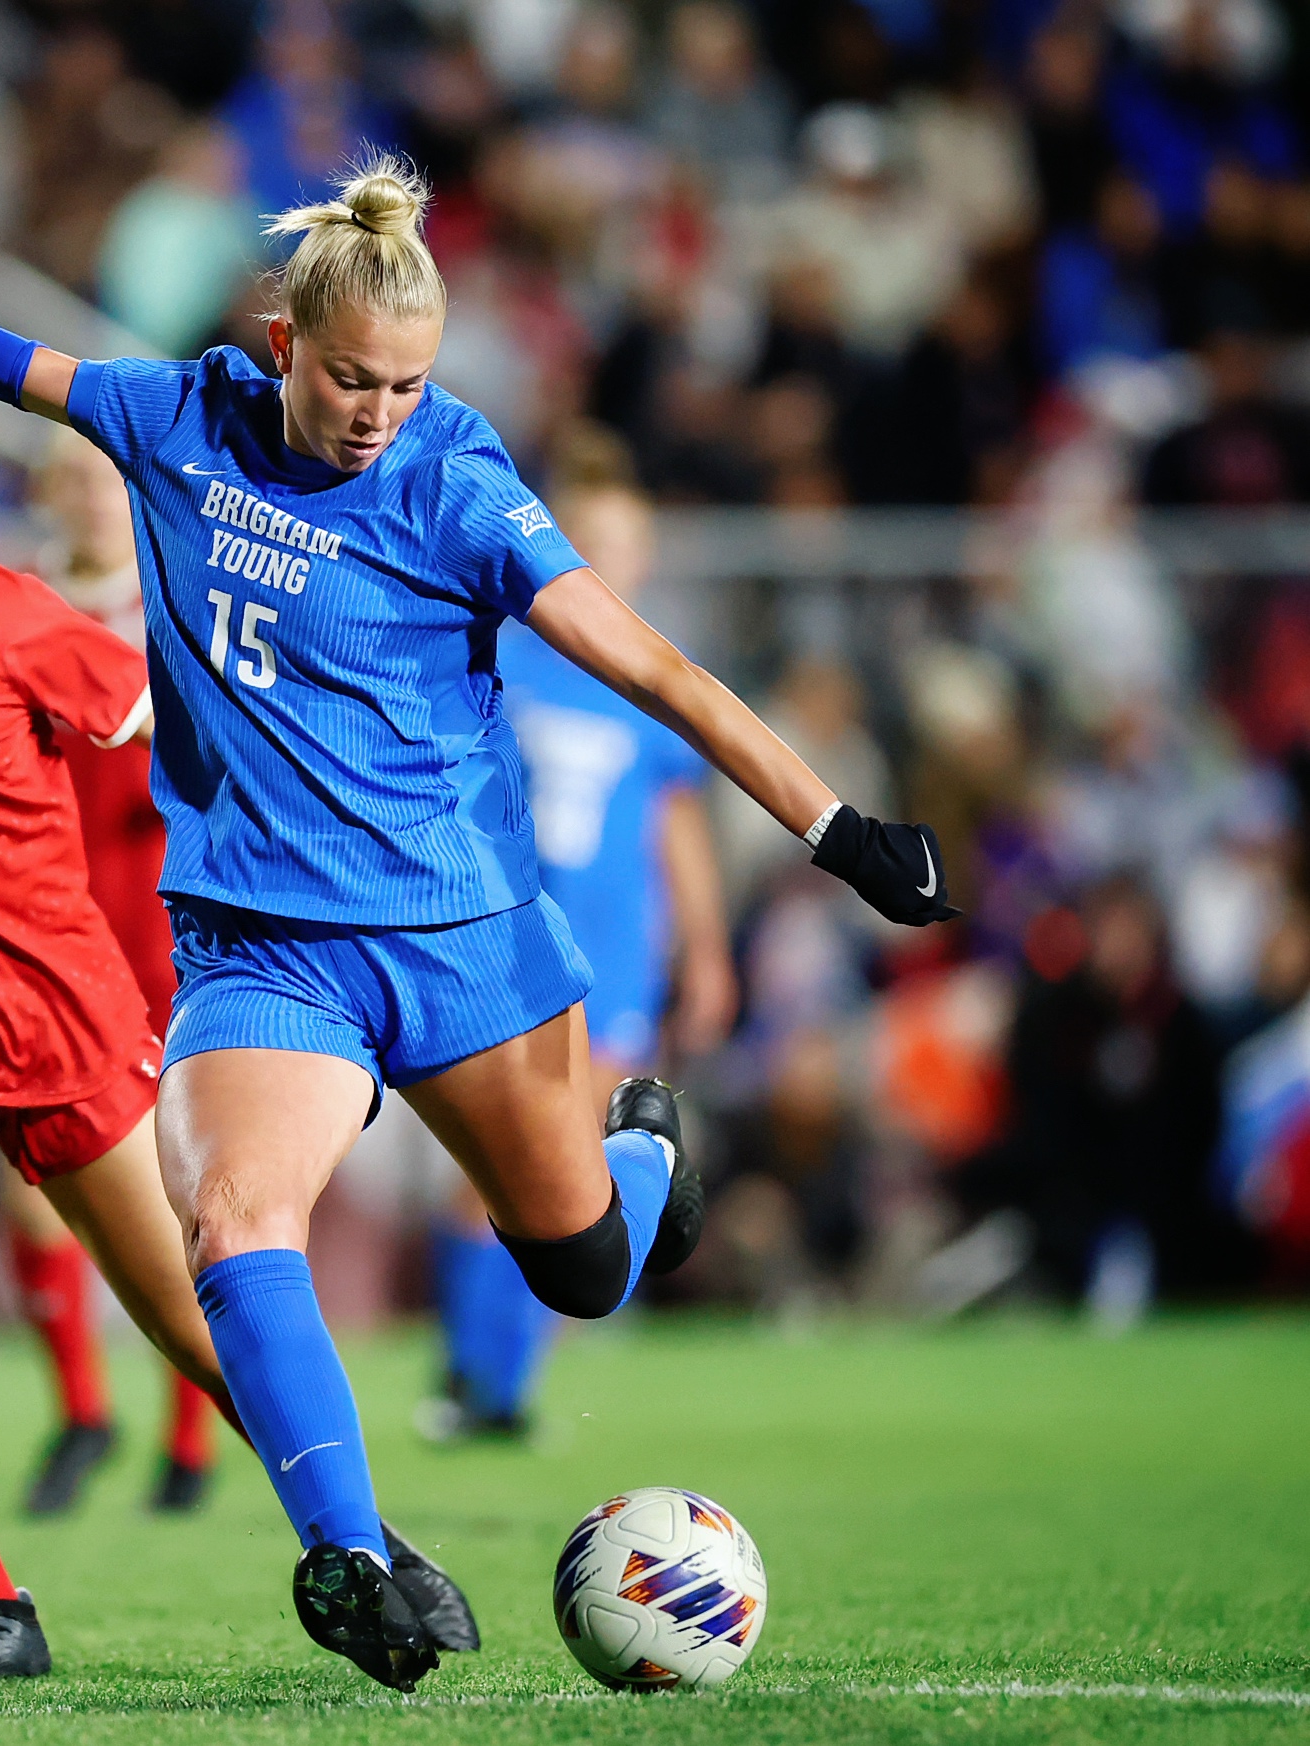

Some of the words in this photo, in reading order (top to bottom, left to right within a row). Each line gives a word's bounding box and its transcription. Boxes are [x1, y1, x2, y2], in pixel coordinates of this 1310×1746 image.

[201, 480, 342, 561] BRIGHAM
[207, 529, 310, 595] YOUNG
[207, 588, 279, 689] 15
